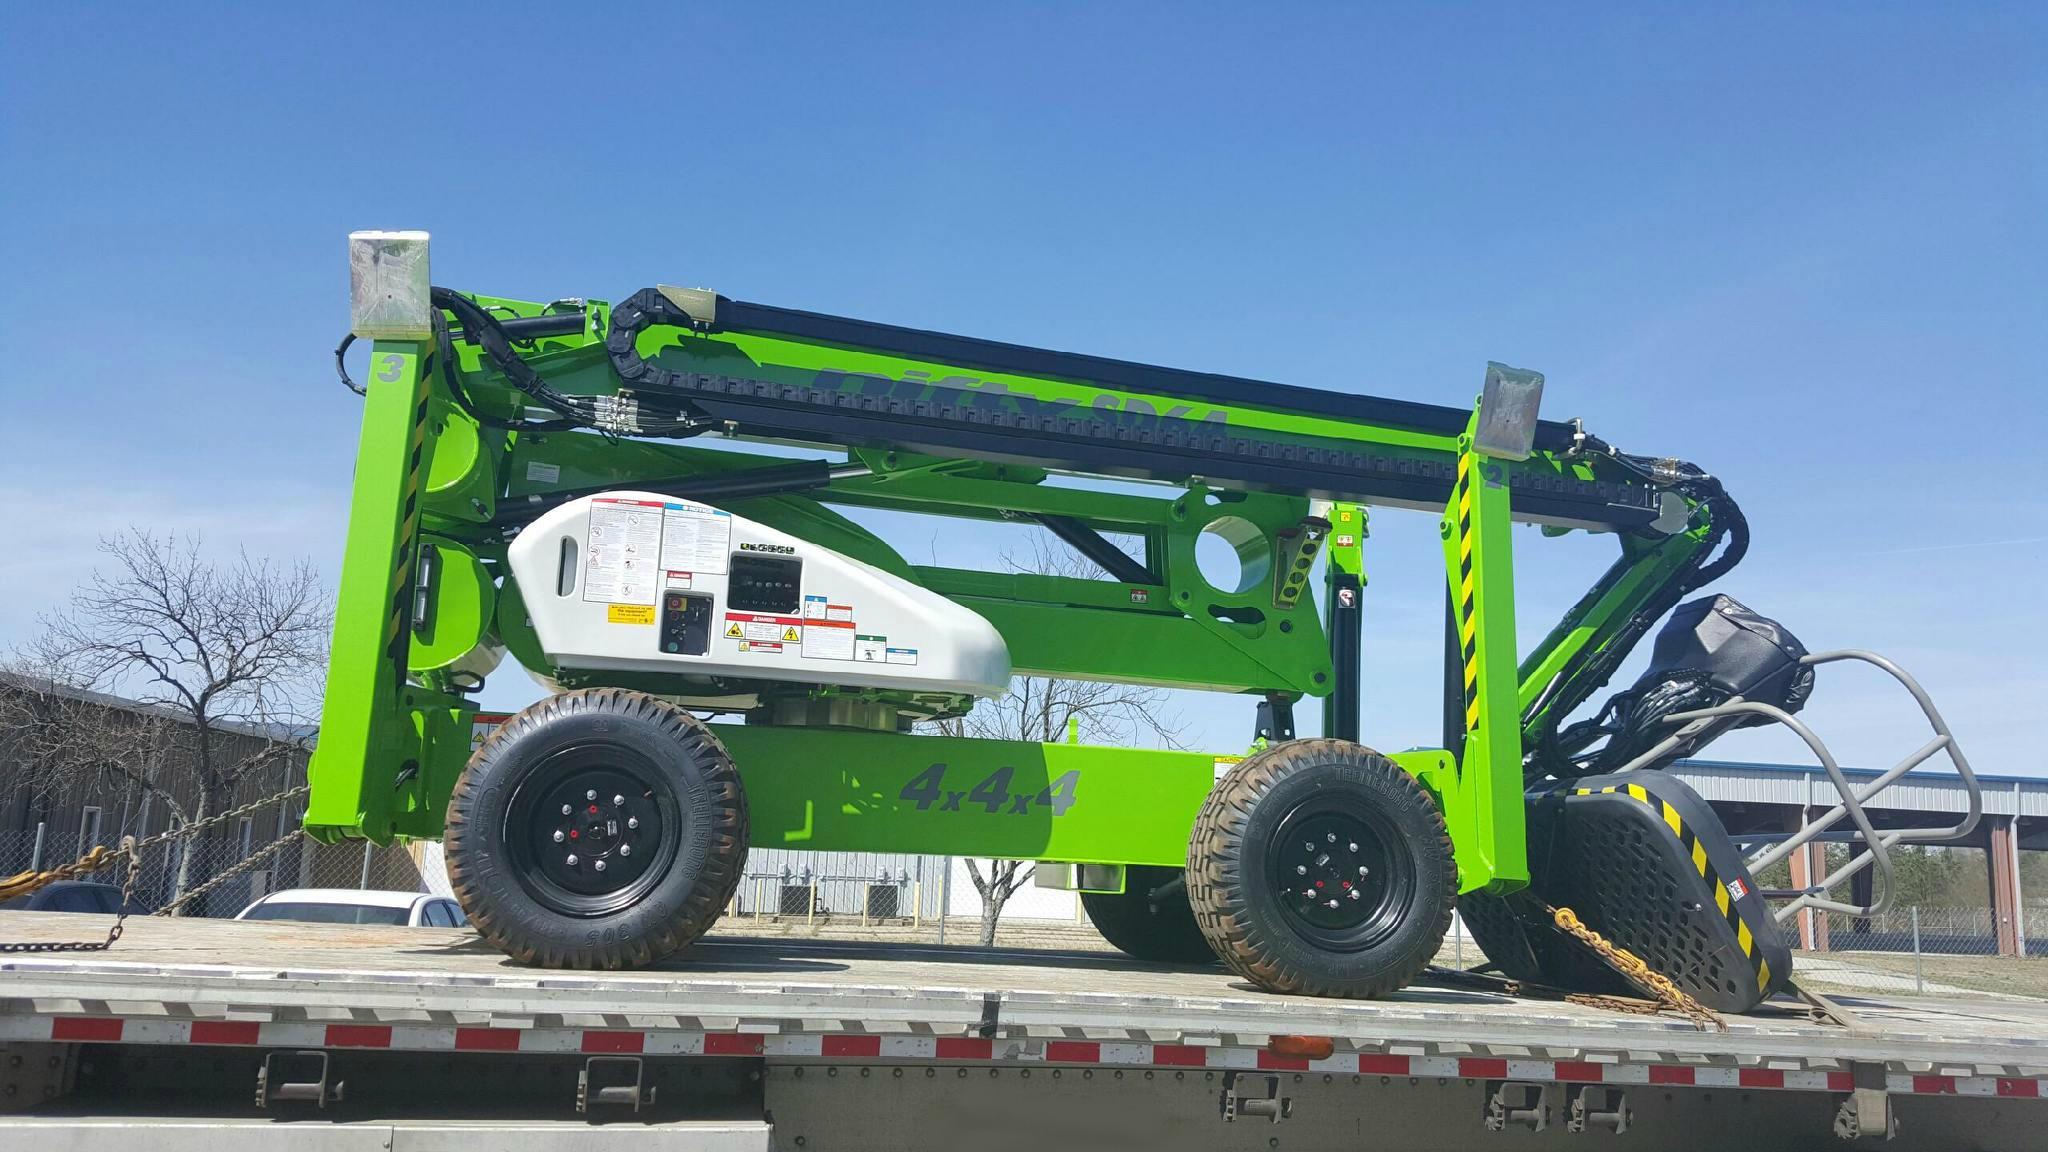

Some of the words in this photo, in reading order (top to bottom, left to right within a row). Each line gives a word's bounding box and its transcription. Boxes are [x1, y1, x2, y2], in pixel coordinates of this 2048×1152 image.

[377, 354, 405, 383] 3
[1484, 464, 1504, 490] 2
[899, 762, 1081, 817] 4x4x4
